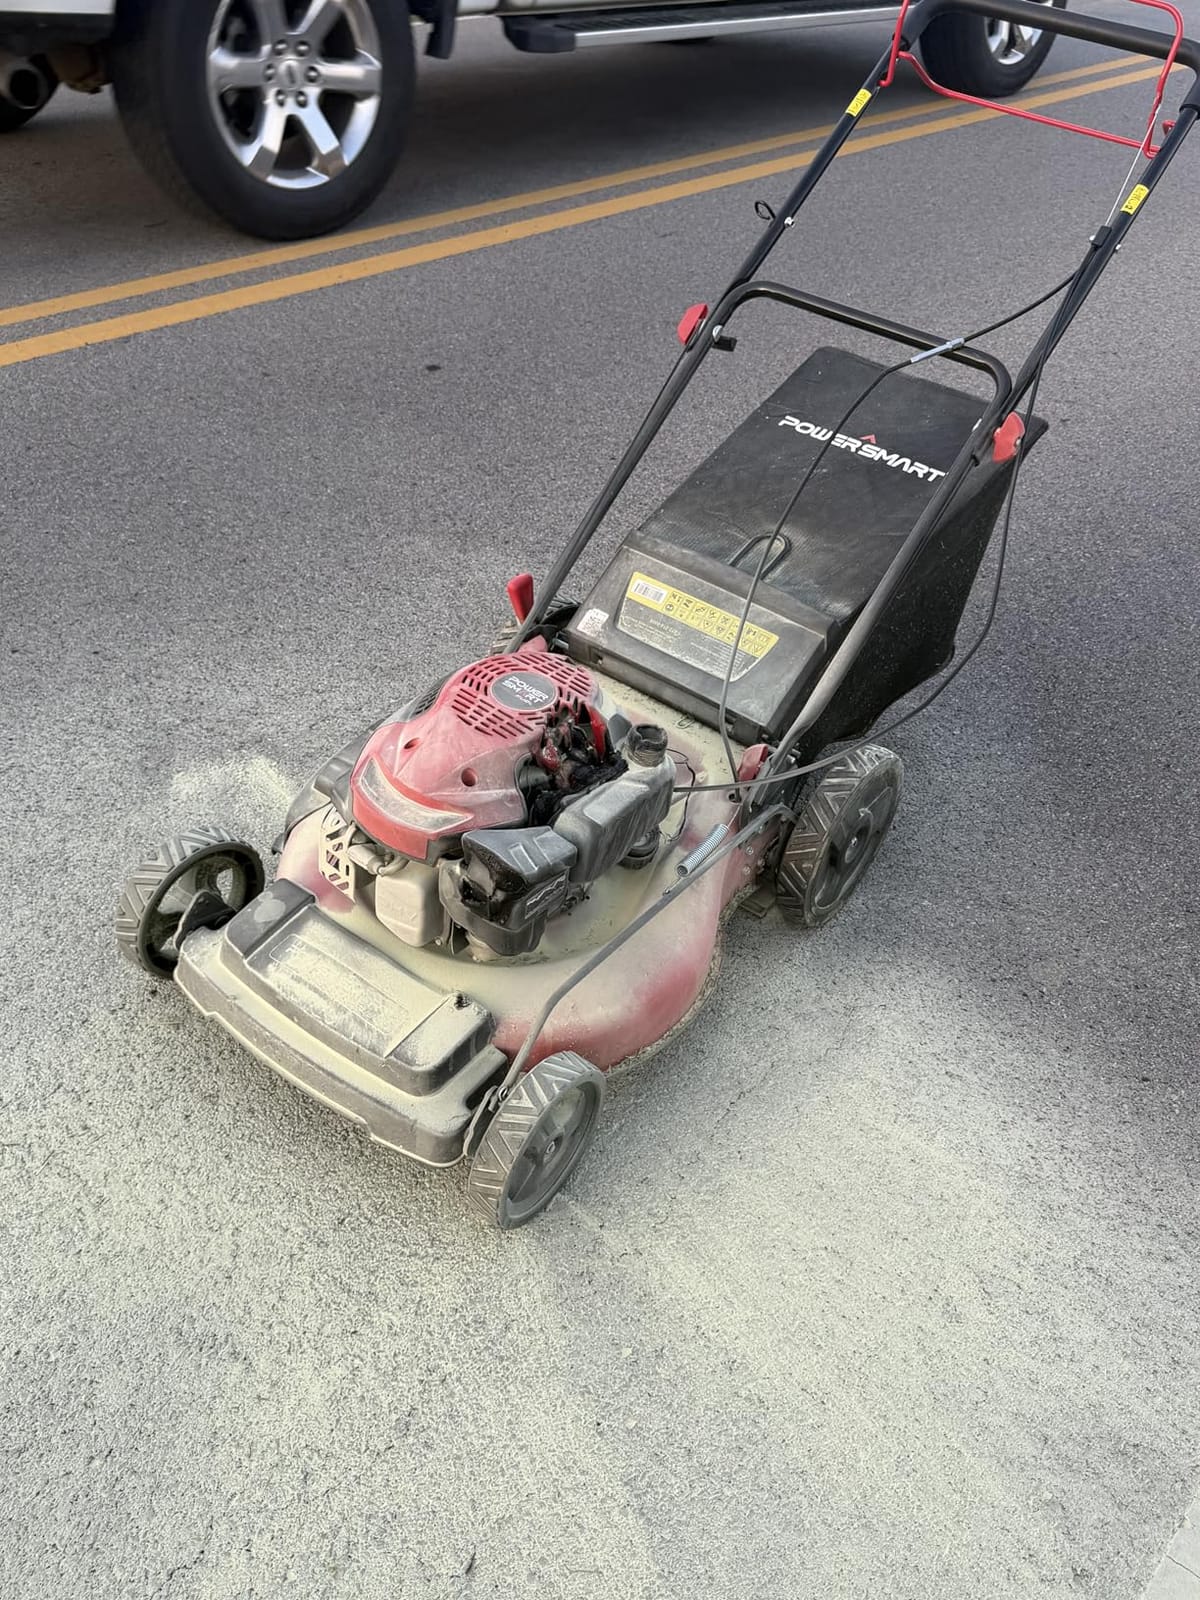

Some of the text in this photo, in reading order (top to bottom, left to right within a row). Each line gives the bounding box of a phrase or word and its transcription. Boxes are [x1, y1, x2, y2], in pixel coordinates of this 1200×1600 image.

[778, 415, 947, 482] POWERSMART
[502, 680, 544, 703] SMART
[508, 675, 549, 700] POWER
